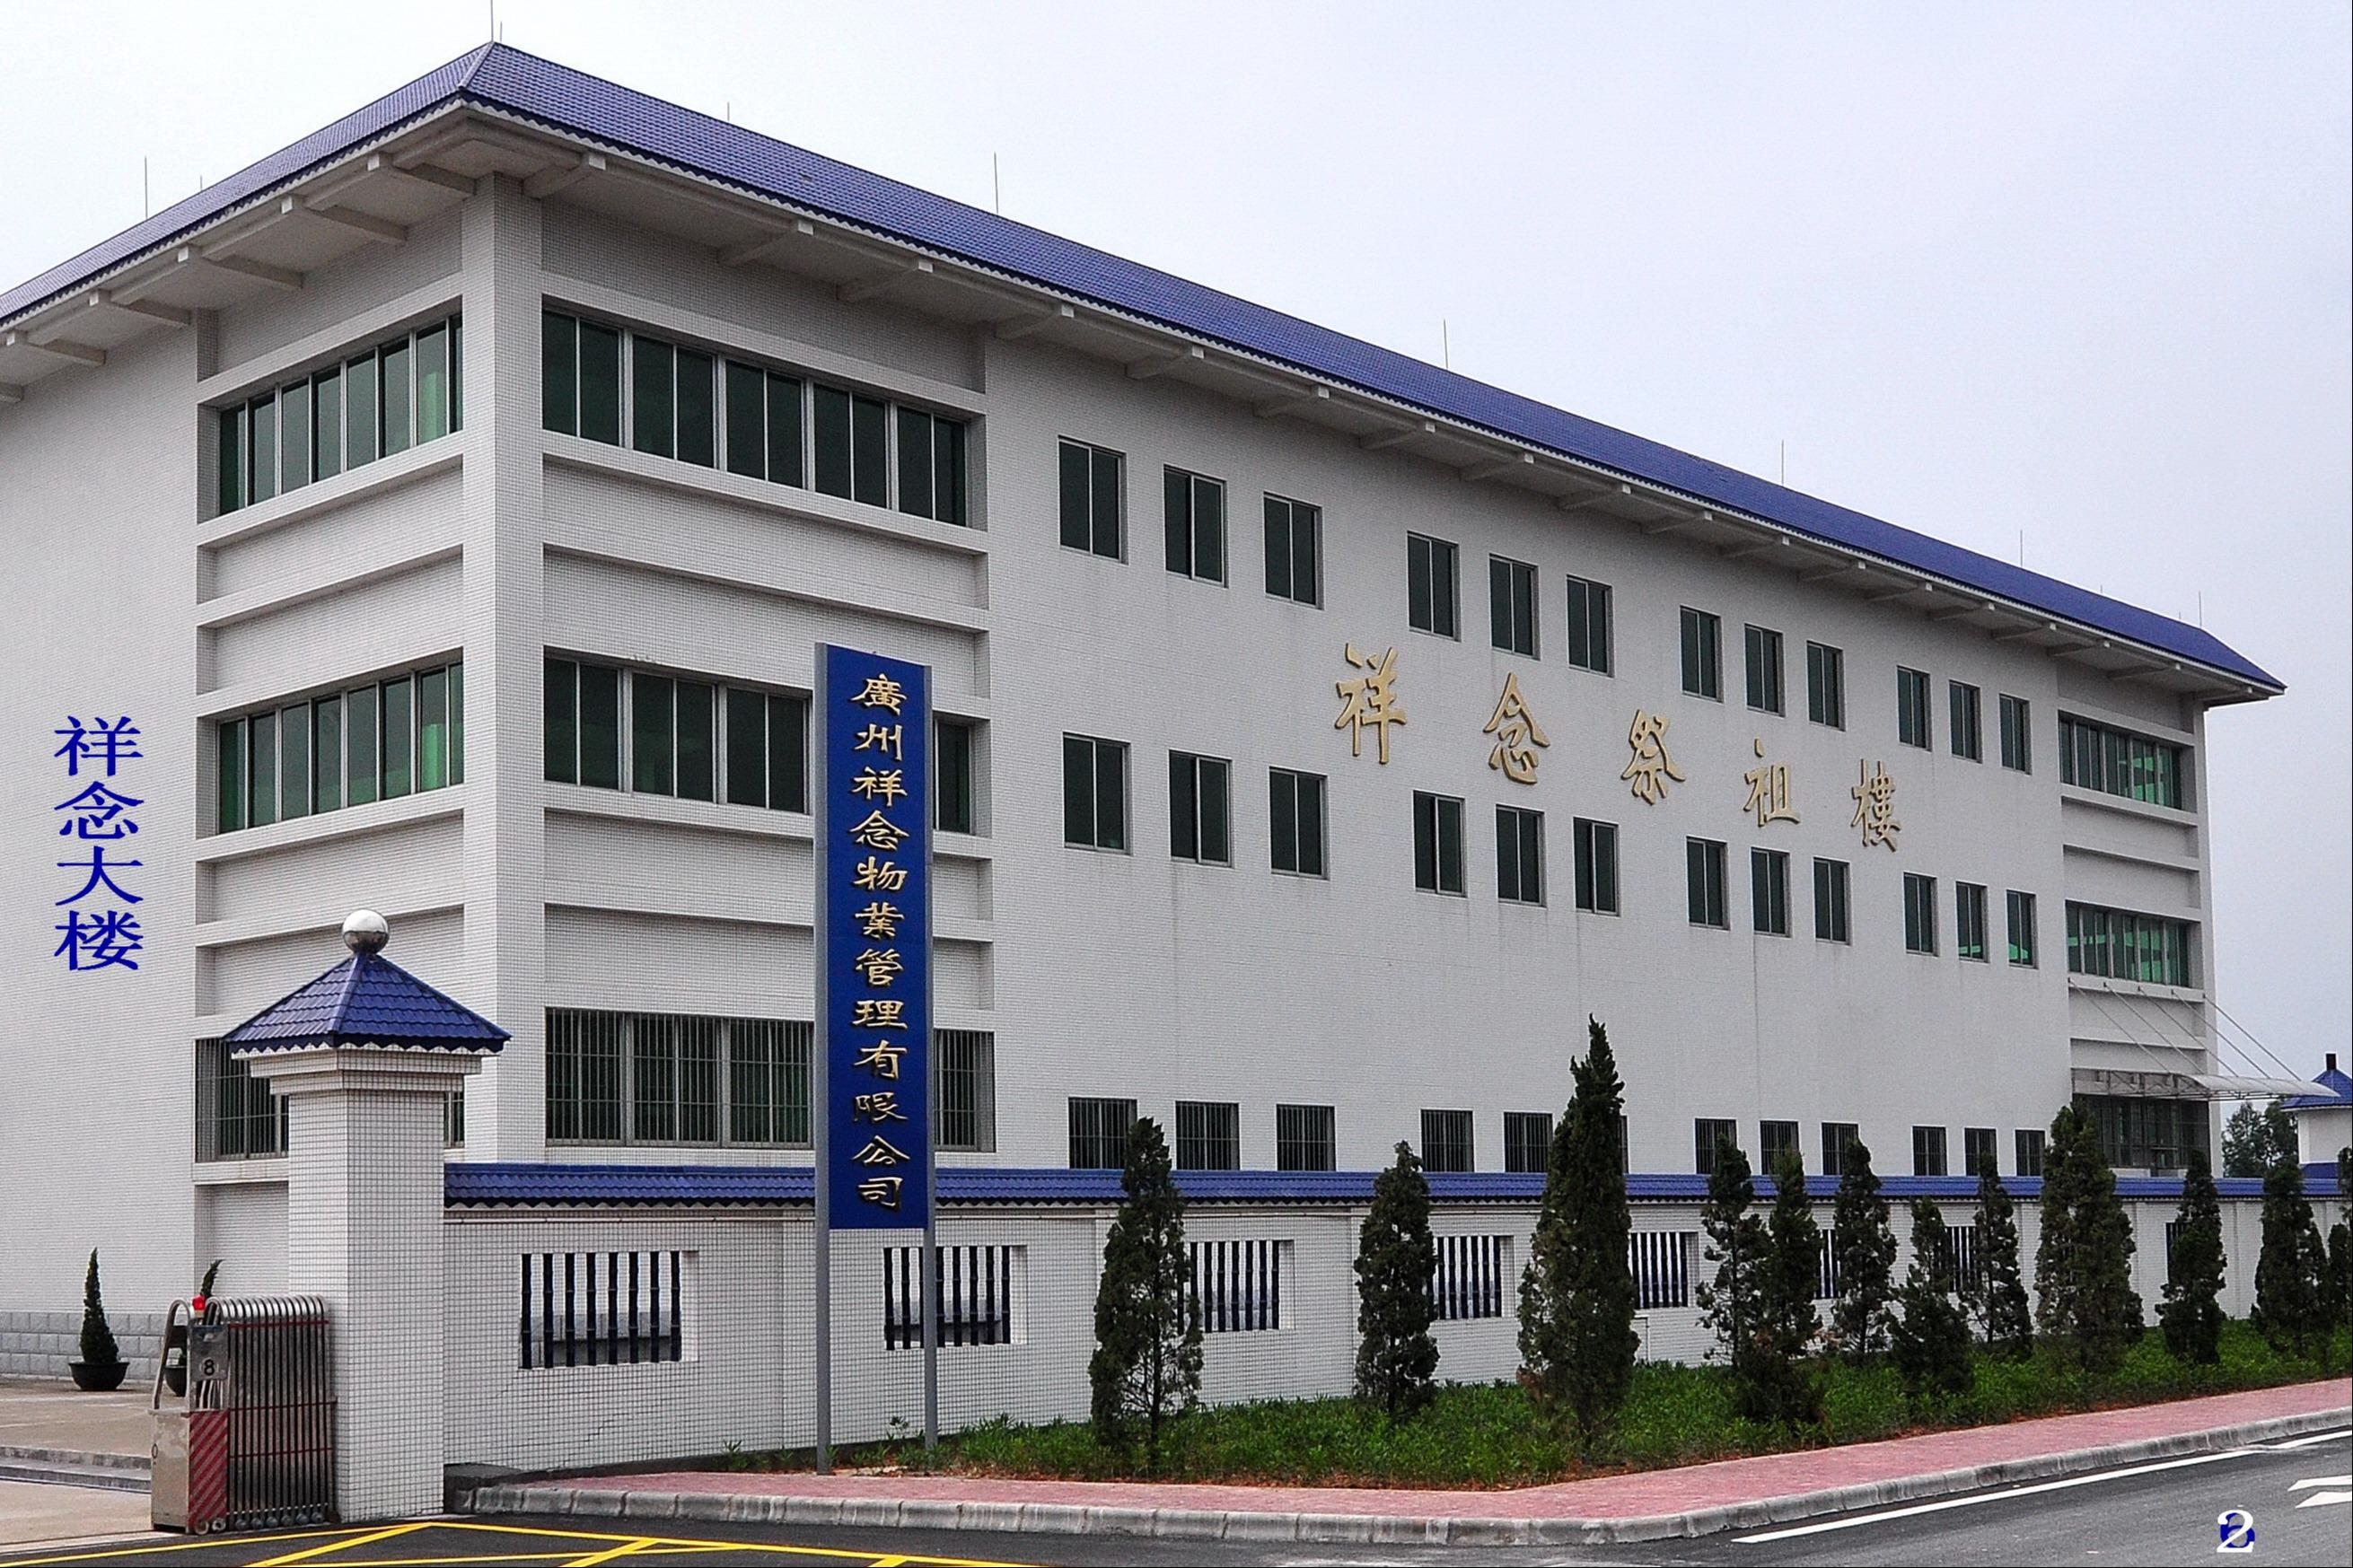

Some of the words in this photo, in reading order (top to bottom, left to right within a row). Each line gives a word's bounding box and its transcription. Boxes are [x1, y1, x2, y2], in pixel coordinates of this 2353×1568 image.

[1335, 643, 1901, 852] 祥念祭祖樓
[849, 674, 909, 1212] 廣州祥念物業管理有限公司
[204, 1359, 215, 1376] 8
